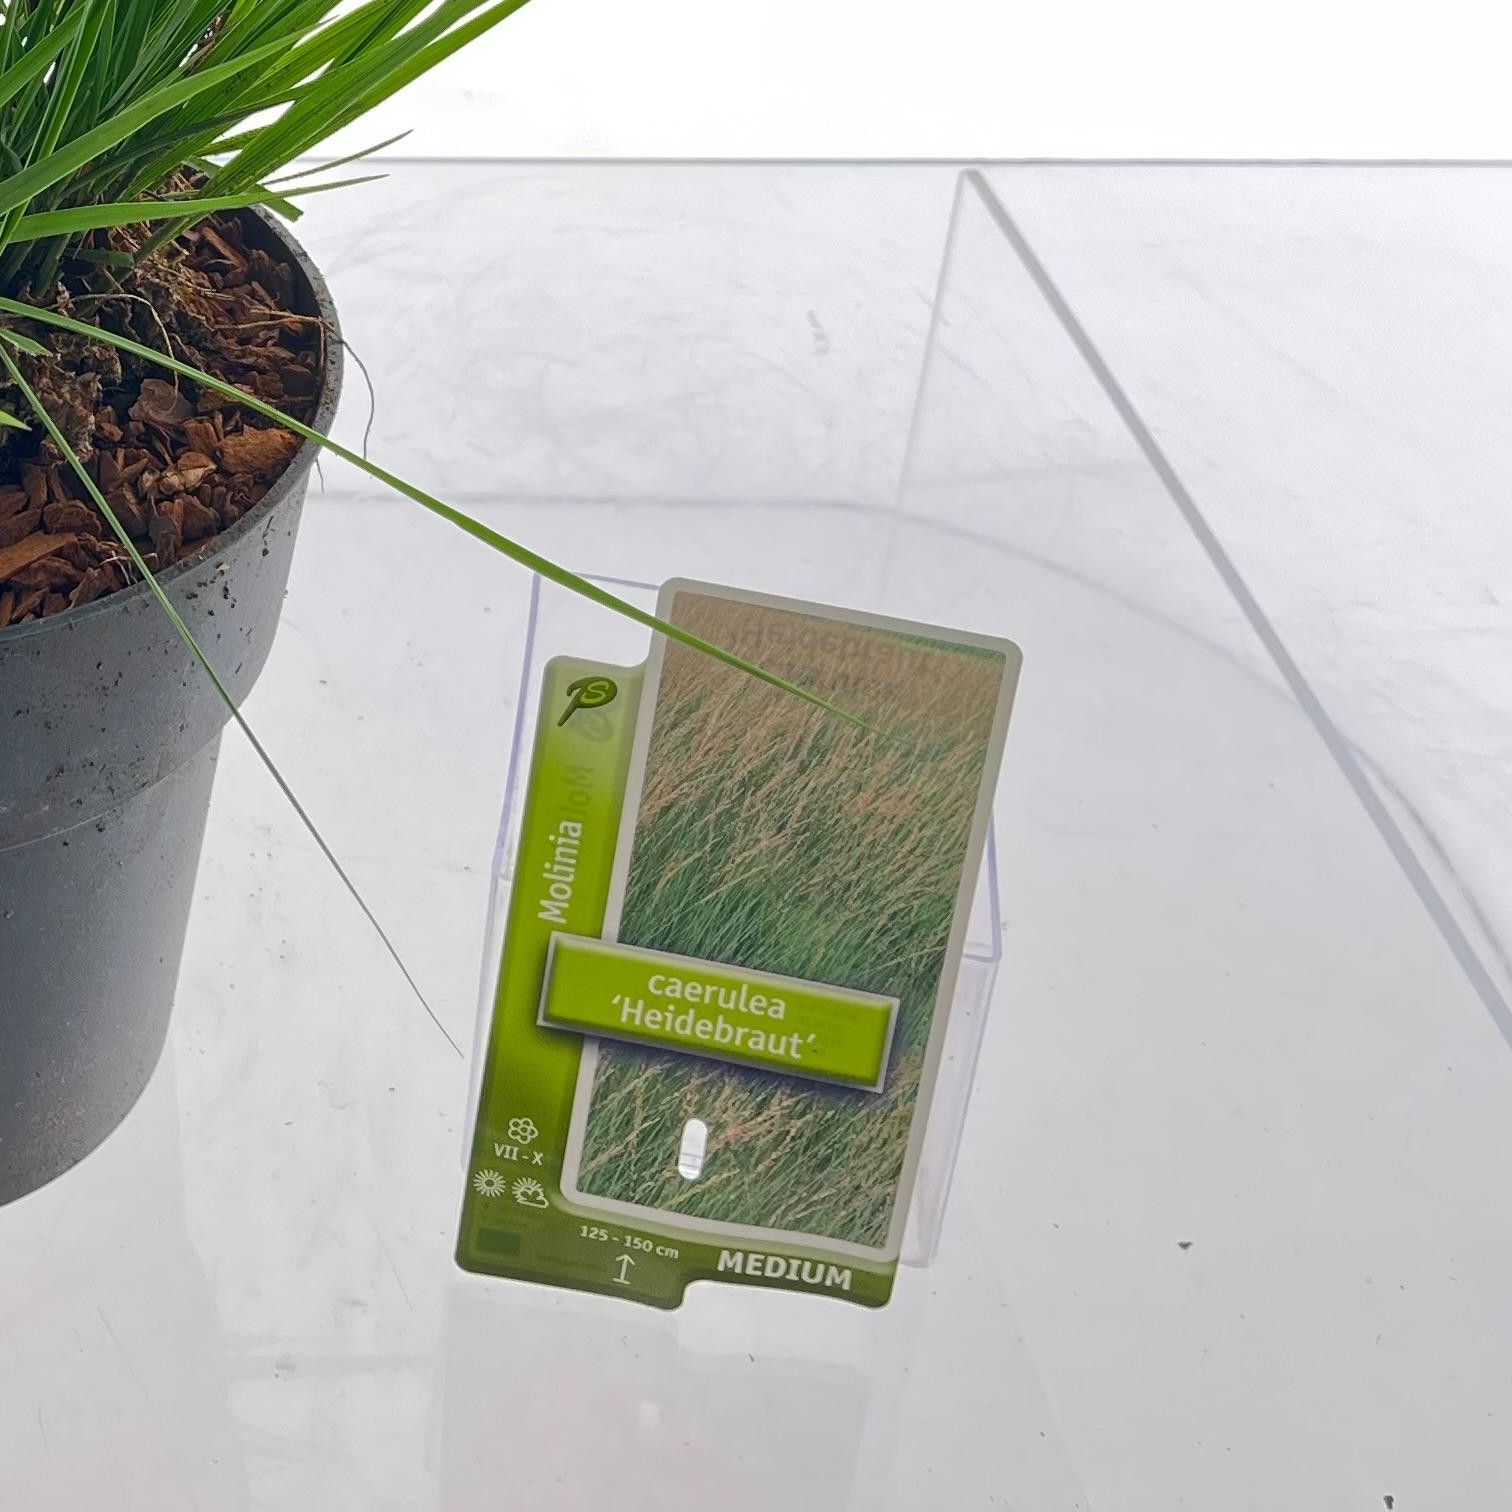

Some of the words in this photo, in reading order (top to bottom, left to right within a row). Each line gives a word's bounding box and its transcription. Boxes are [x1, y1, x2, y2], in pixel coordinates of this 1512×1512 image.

[538, 820, 583, 924] Molinia
[647, 974, 786, 1020] caerulea
[494, 1142, 519, 1161] VII
[531, 1151, 543, 1166] X
[580, 1225, 608, 1241] 125
[624, 1235, 653, 1252] 150
[656, 1246, 679, 1259] cm
[717, 1249, 853, 1290] MEDIUM
